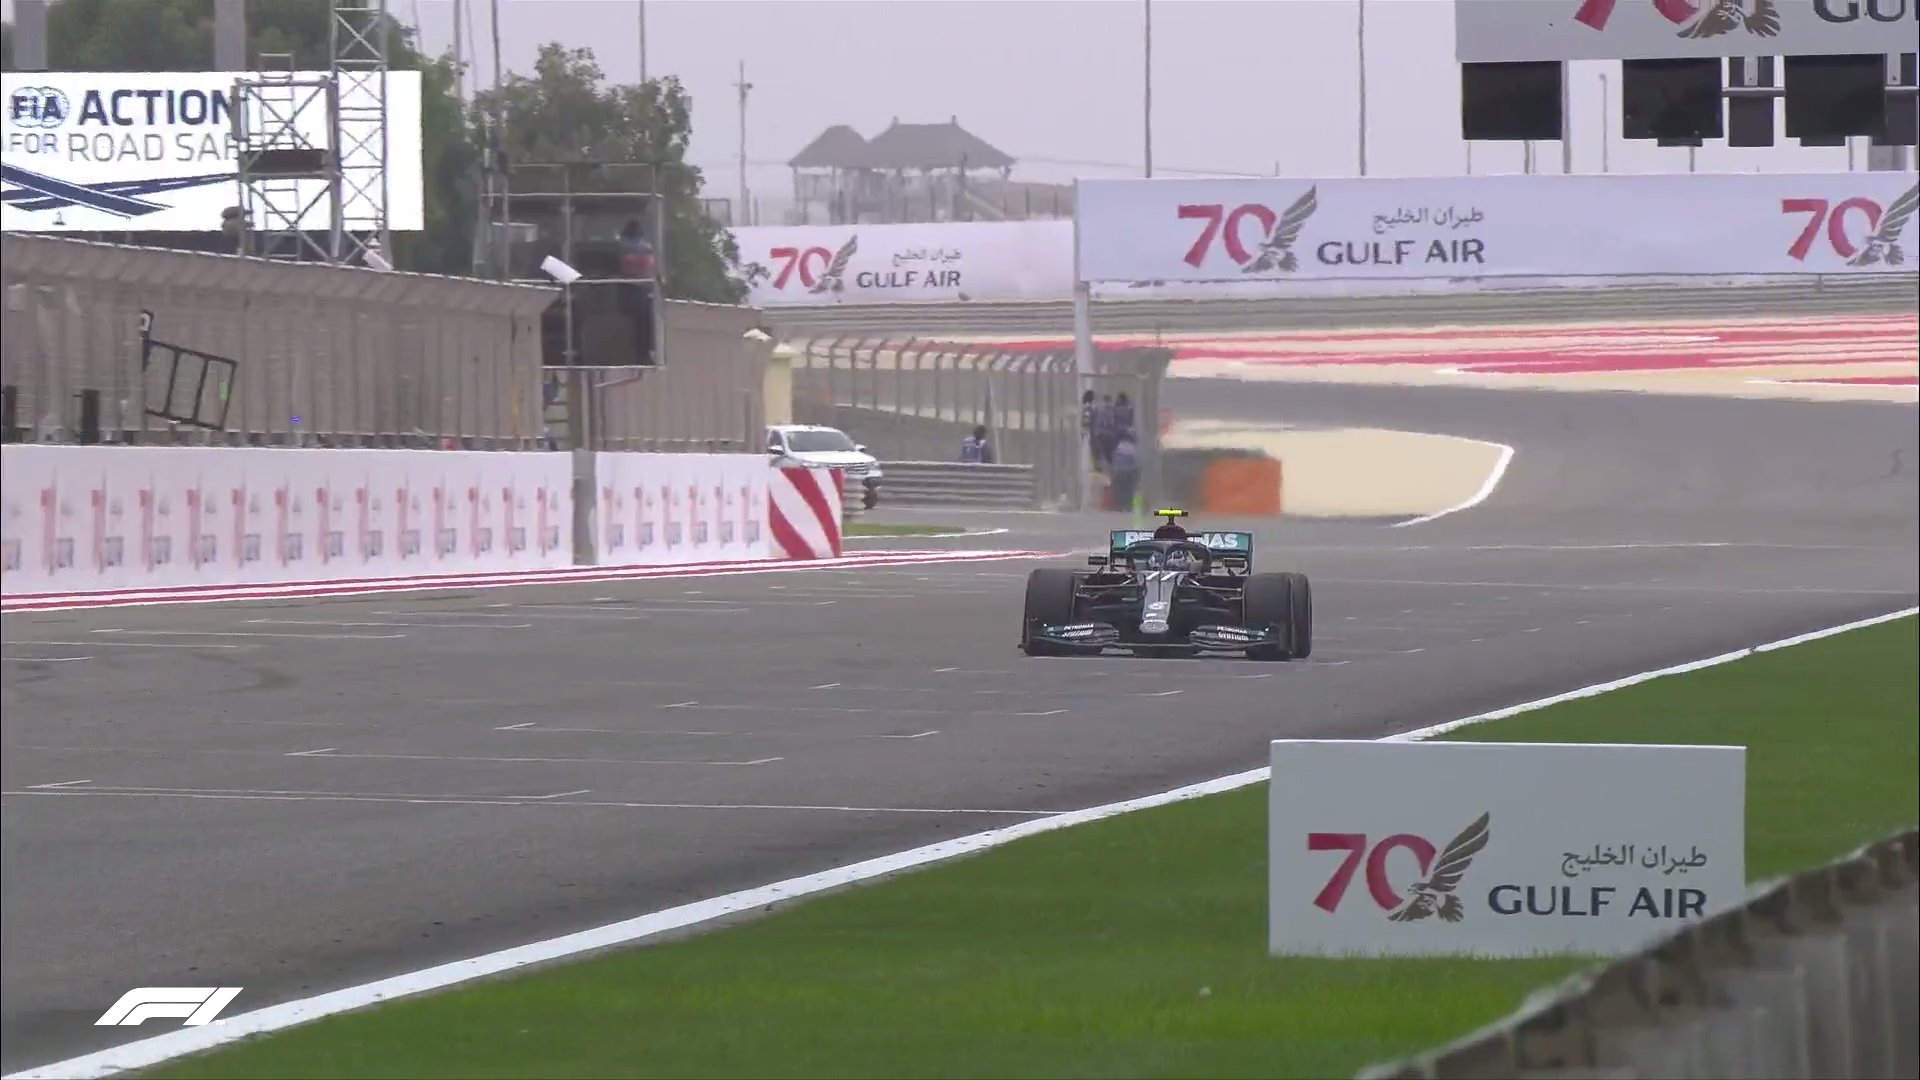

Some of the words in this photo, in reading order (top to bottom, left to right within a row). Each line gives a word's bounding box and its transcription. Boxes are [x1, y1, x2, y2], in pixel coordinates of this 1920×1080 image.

[1813, 0, 1919, 22] GU
[10, 133, 59, 154] FOR
[68, 133, 164, 162] ROAD
[1177, 203, 1277, 268] 70
[1782, 197, 1883, 261] 70
[1317, 240, 1416, 265] GULF
[1424, 239, 1485, 264] AIR
[770, 247, 832, 290] 70
[856, 270, 918, 288] GULF
[924, 270, 961, 288] AIR
[1125, 532, 1238, 549] PENAS
[1307, 832, 1437, 913] 70
[1562, 844, 1634, 878] الخليج
[1641, 845, 1707, 875] طيران
[1487, 885, 1616, 917] GULF
[1628, 887, 1707, 918] AIR
